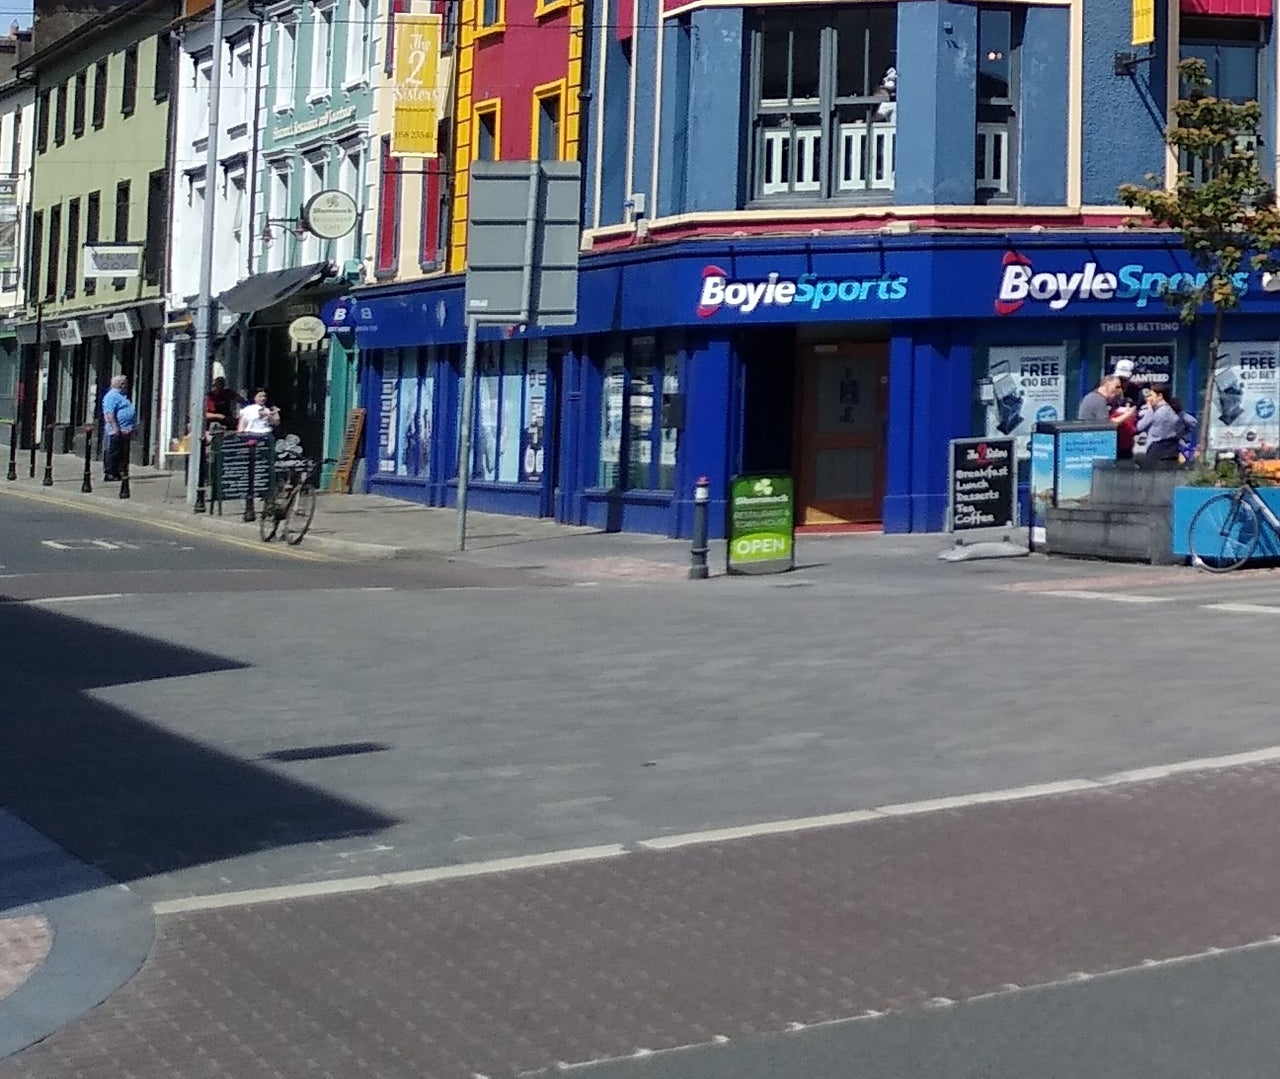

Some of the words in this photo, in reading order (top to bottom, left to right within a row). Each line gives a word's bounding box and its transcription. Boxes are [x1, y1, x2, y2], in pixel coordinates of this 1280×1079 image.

[701, 272, 908, 312] BoyleSports
[1101, 323, 1123, 331] THIS
[1125, 323, 1135, 331] IS
[1137, 323, 1179, 331] BETTING
[1140, 356, 1169, 365] ODDS
[1240, 357, 1276, 369] FREE
[1020, 363, 1059, 376] FREE
[1040, 378, 1059, 386] BET
[956, 466, 1009, 479] Breakfast
[956, 479, 989, 491] Lunch
[956, 490, 1000, 502] Desserts
[956, 504, 975, 513] Tea
[954, 511, 995, 524] Coffee
[737, 537, 785, 554] OPEN
